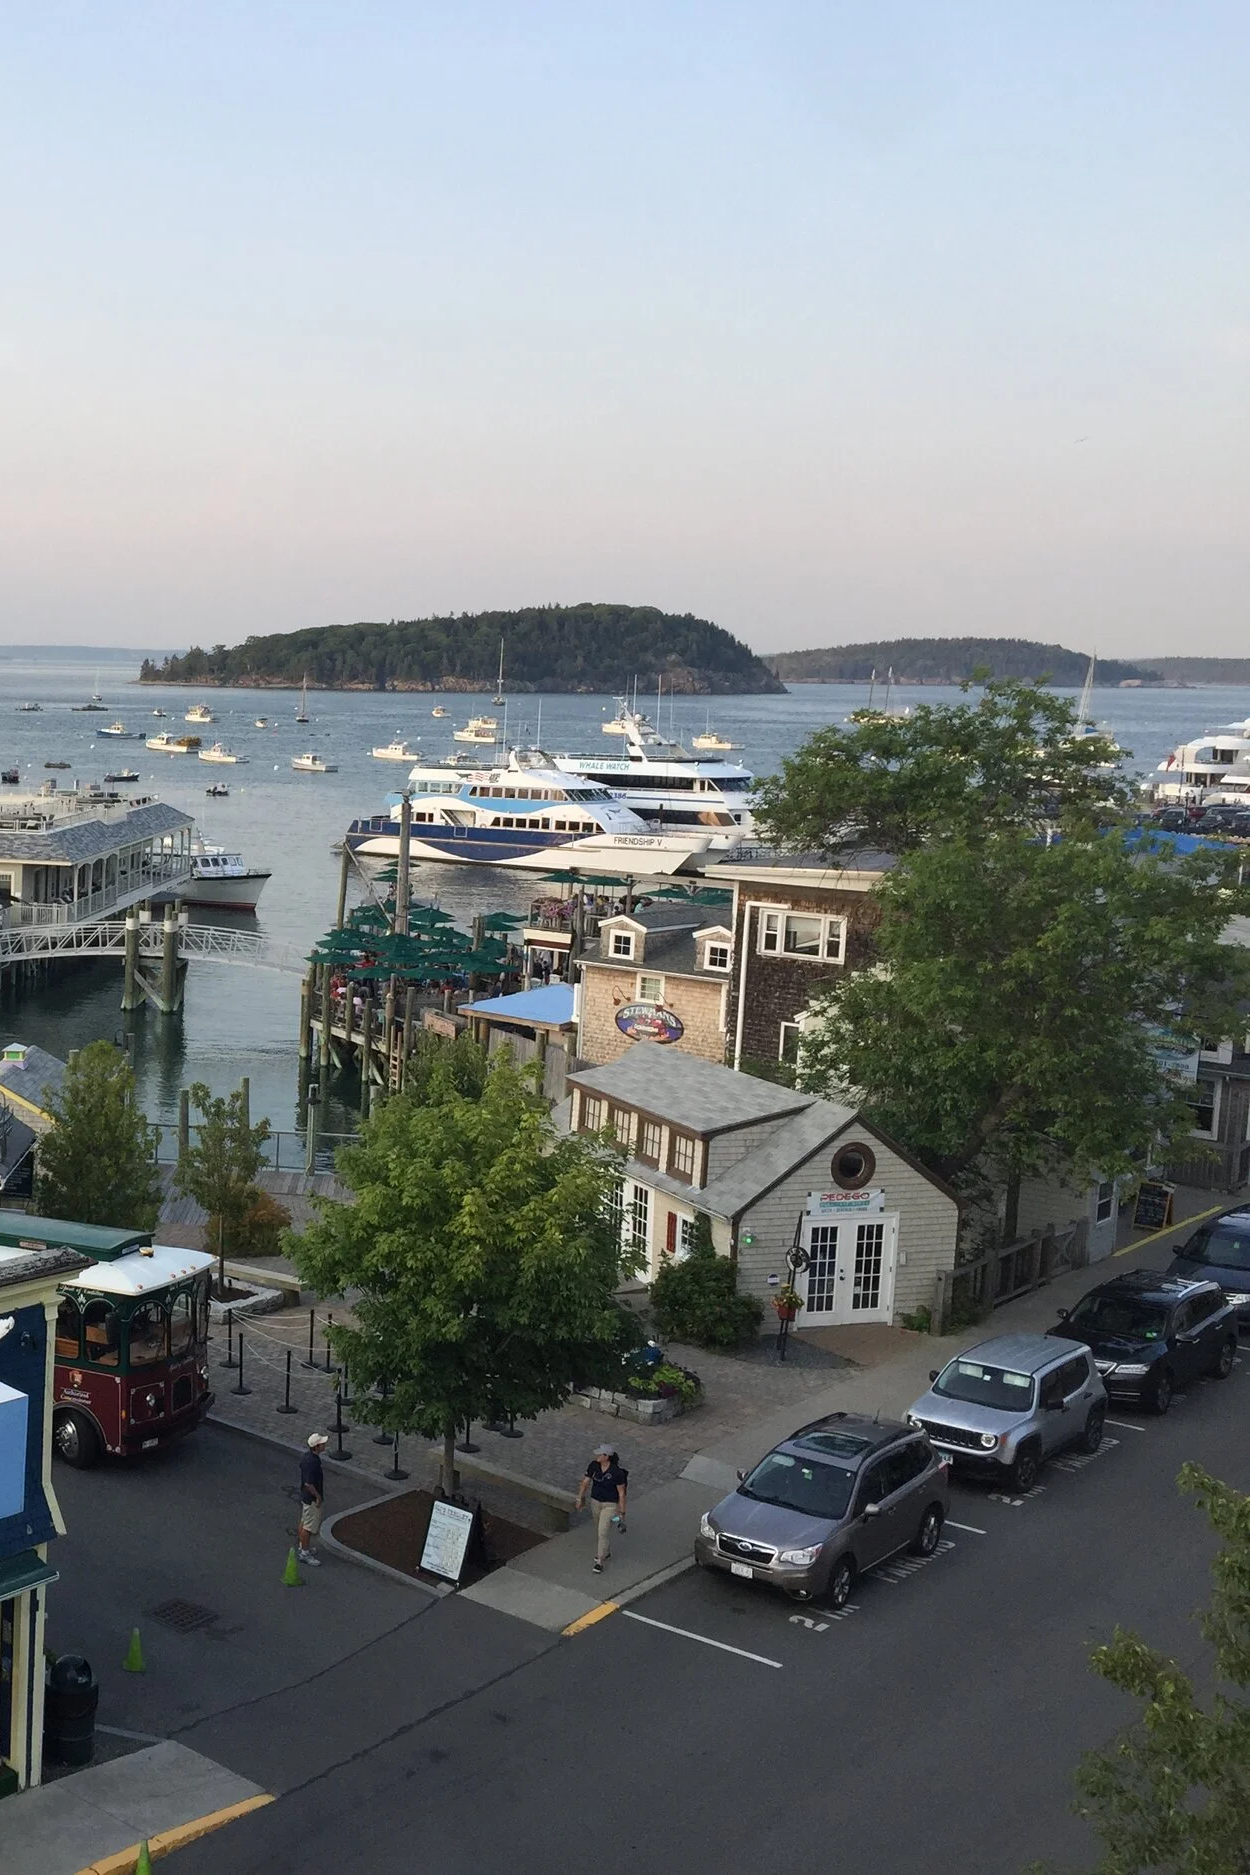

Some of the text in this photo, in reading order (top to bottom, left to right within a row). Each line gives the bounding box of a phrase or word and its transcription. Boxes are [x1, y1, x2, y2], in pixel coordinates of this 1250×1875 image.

[579, 762, 630, 771] WHALE WATCH
[613, 836, 655, 846] FRIENDSHIP
[820, 1192, 870, 1202] PEDEGO
